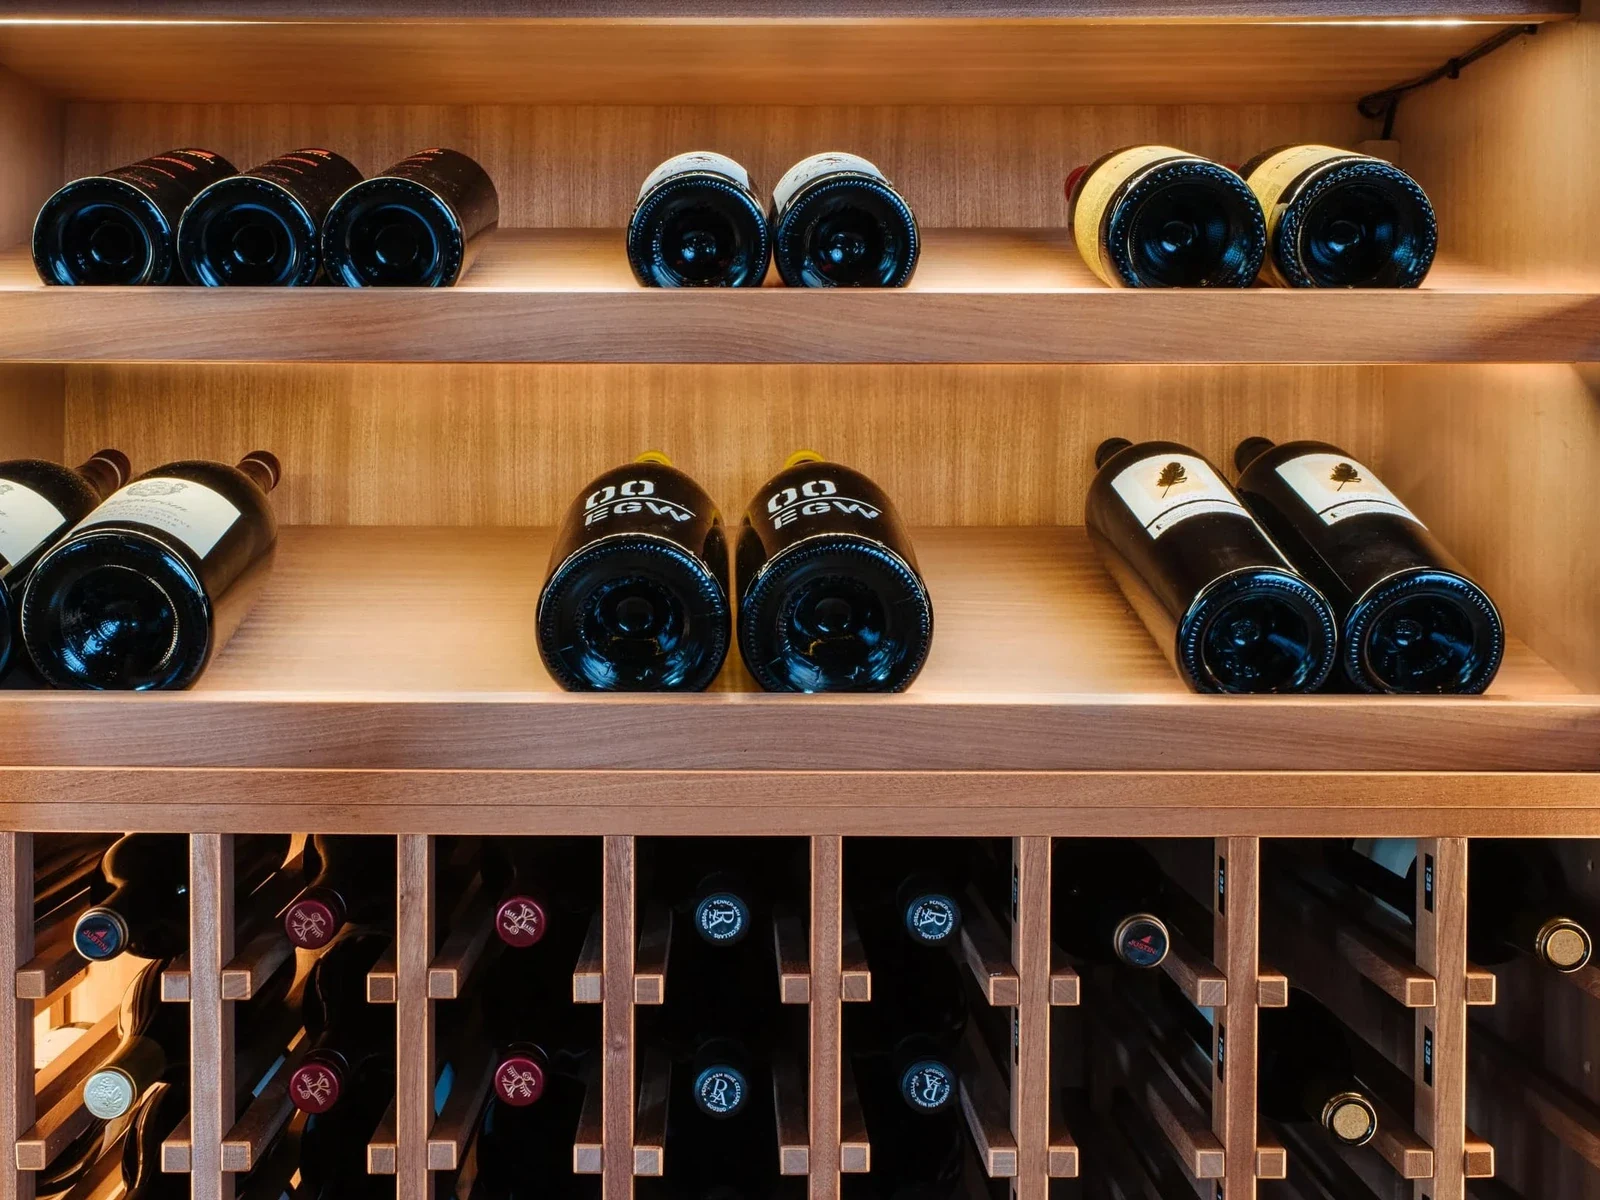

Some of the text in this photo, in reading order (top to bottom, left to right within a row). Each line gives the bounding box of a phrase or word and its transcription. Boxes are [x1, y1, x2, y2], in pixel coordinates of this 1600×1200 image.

[585, 501, 691, 526] EGW
[774, 501, 879, 530] EGW
[1128, 939, 1157, 955] JUSTIN
